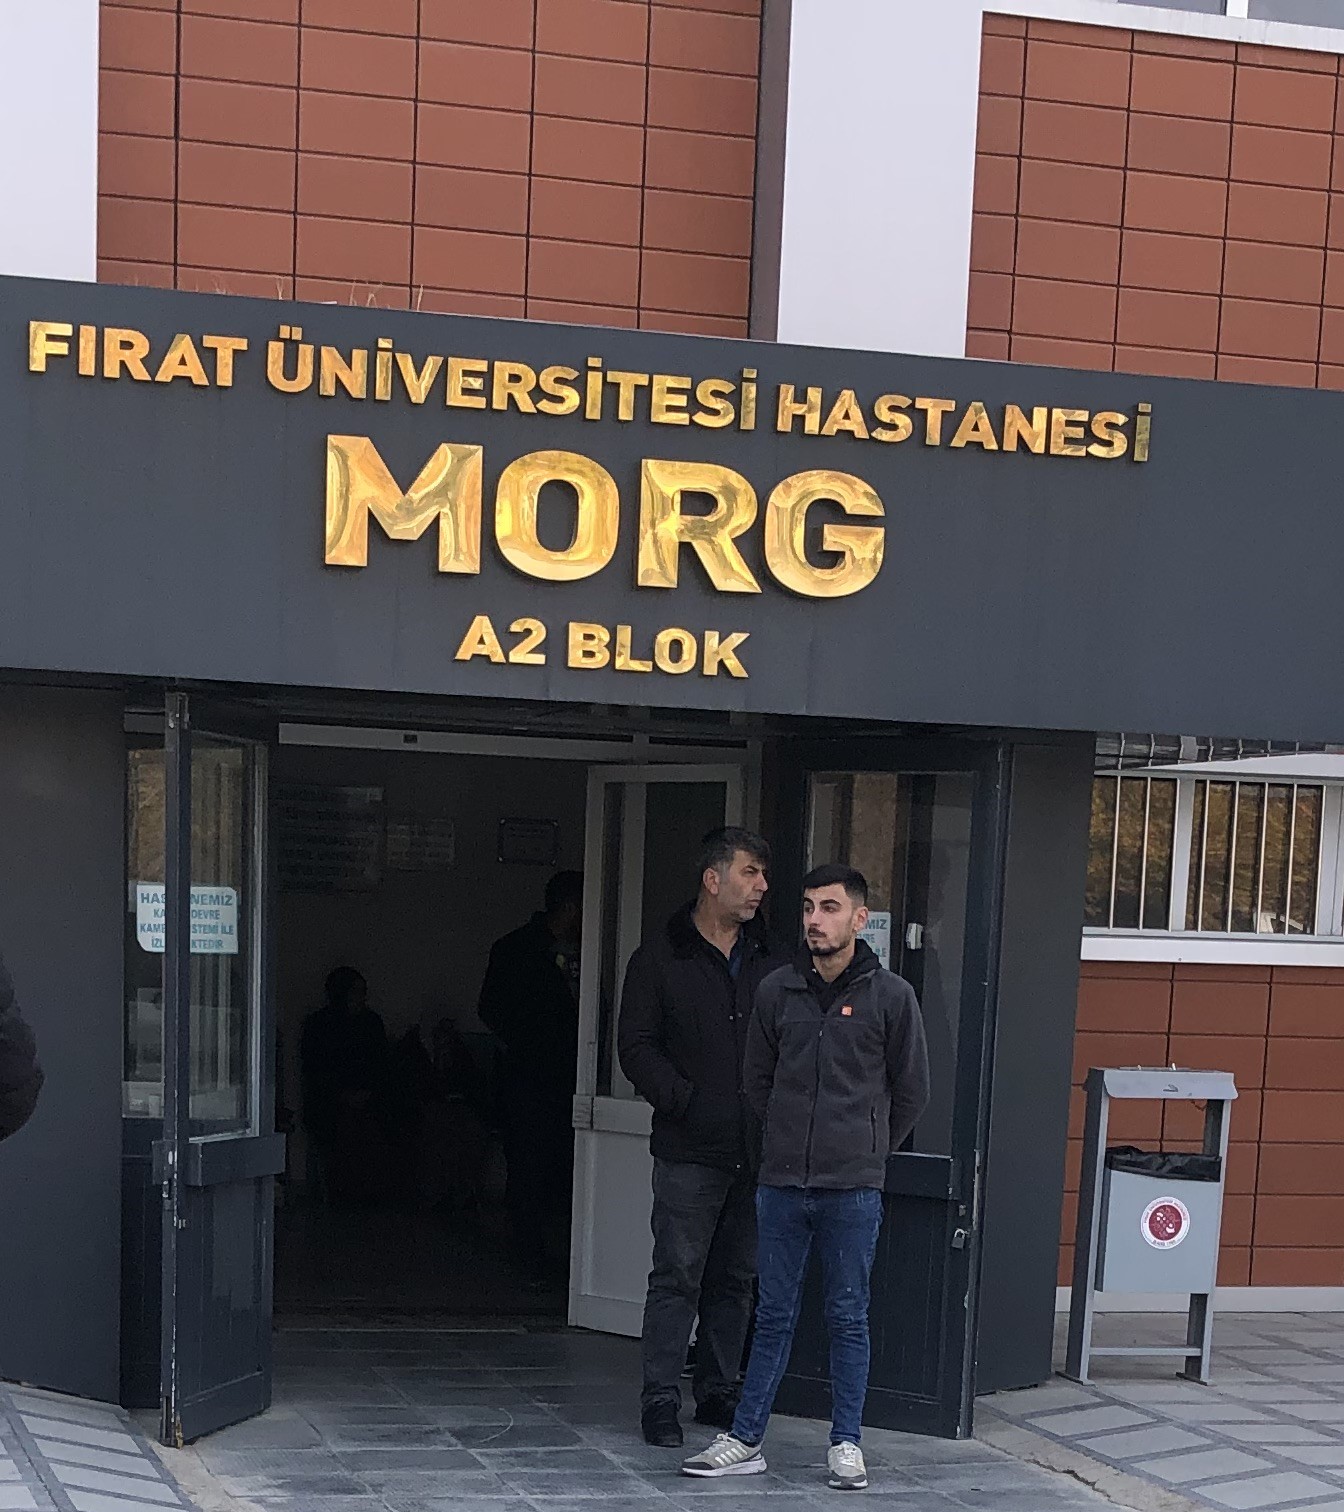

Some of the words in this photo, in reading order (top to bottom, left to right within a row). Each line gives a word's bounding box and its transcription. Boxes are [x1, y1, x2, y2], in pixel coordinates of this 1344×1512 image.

[29, 321, 248, 386] FIRAT
[267, 325, 757, 431] ÜNİVERSİTESİ
[777, 384, 1152, 461] HASTANESİ
[325, 434, 886, 597] MORG
[455, 615, 546, 665] A2
[567, 621, 749, 678] BLOK
